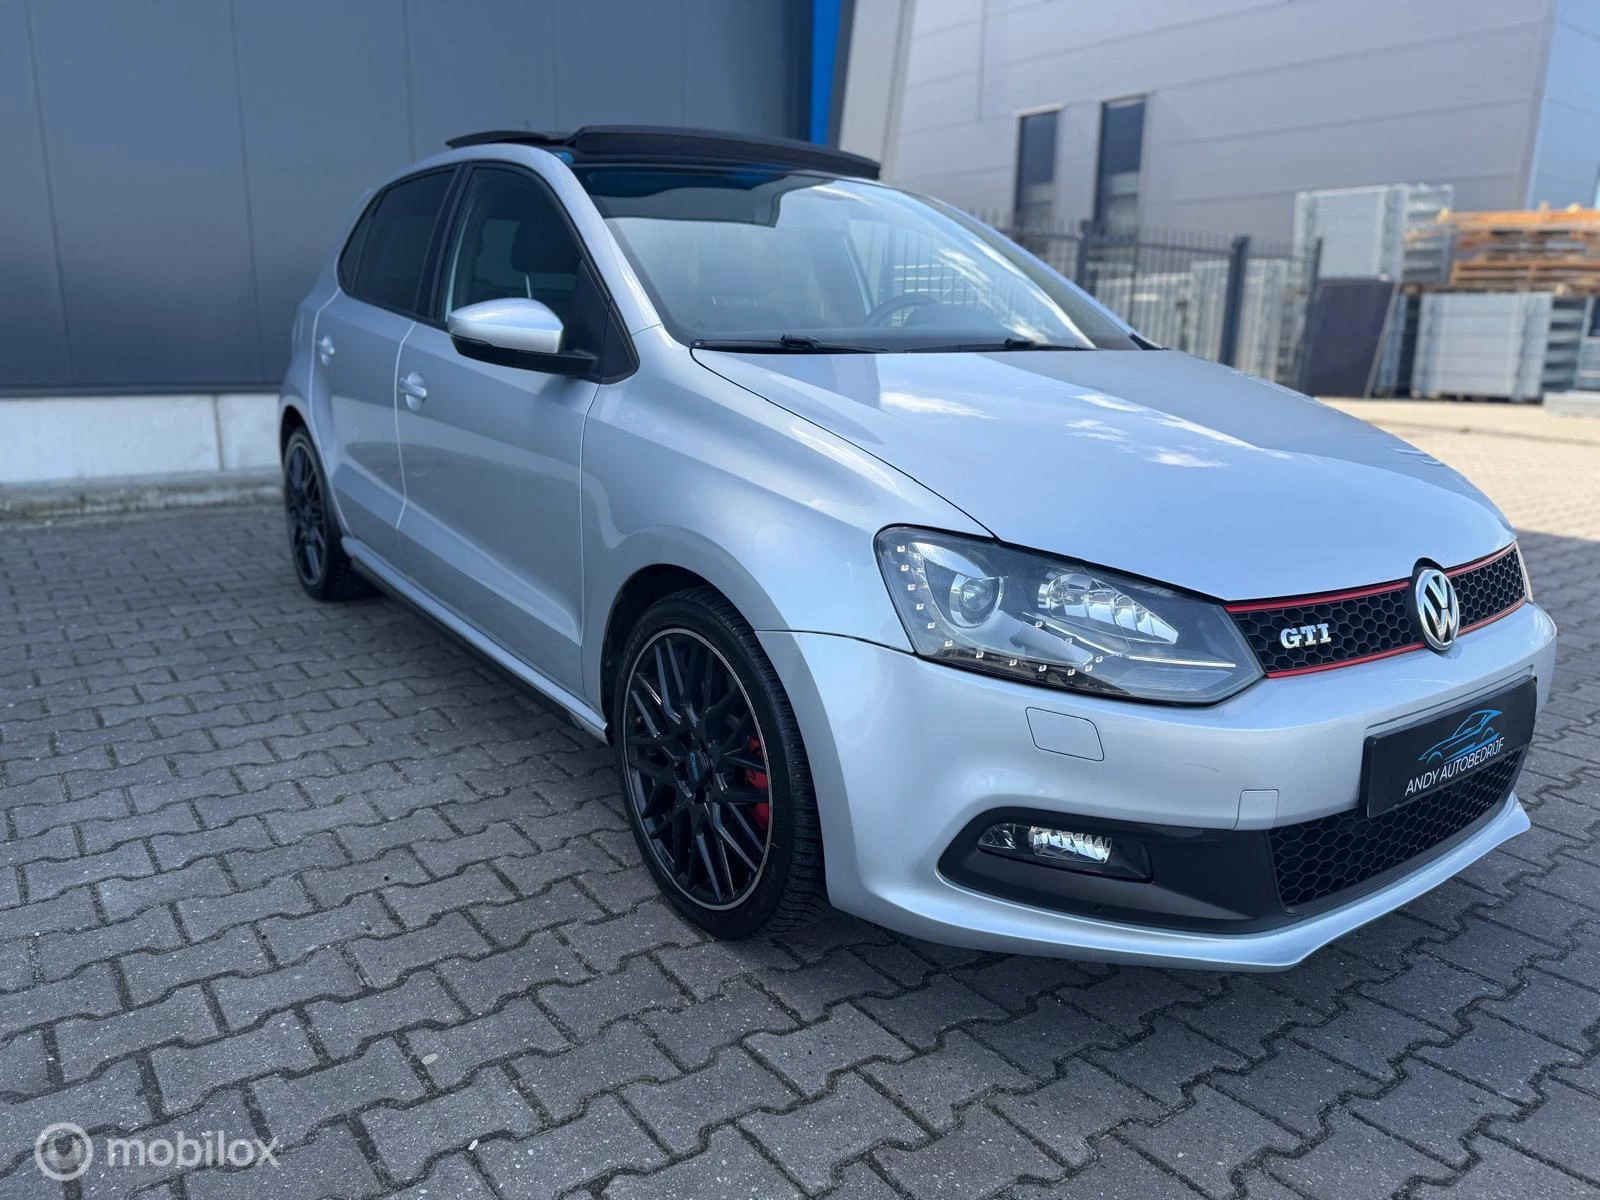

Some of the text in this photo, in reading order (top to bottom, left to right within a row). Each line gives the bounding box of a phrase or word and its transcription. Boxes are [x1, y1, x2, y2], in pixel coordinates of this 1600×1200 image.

[1281, 623, 1331, 648] GTI
[1404, 737, 1505, 796] ANDY AUTOBEDRIJF
